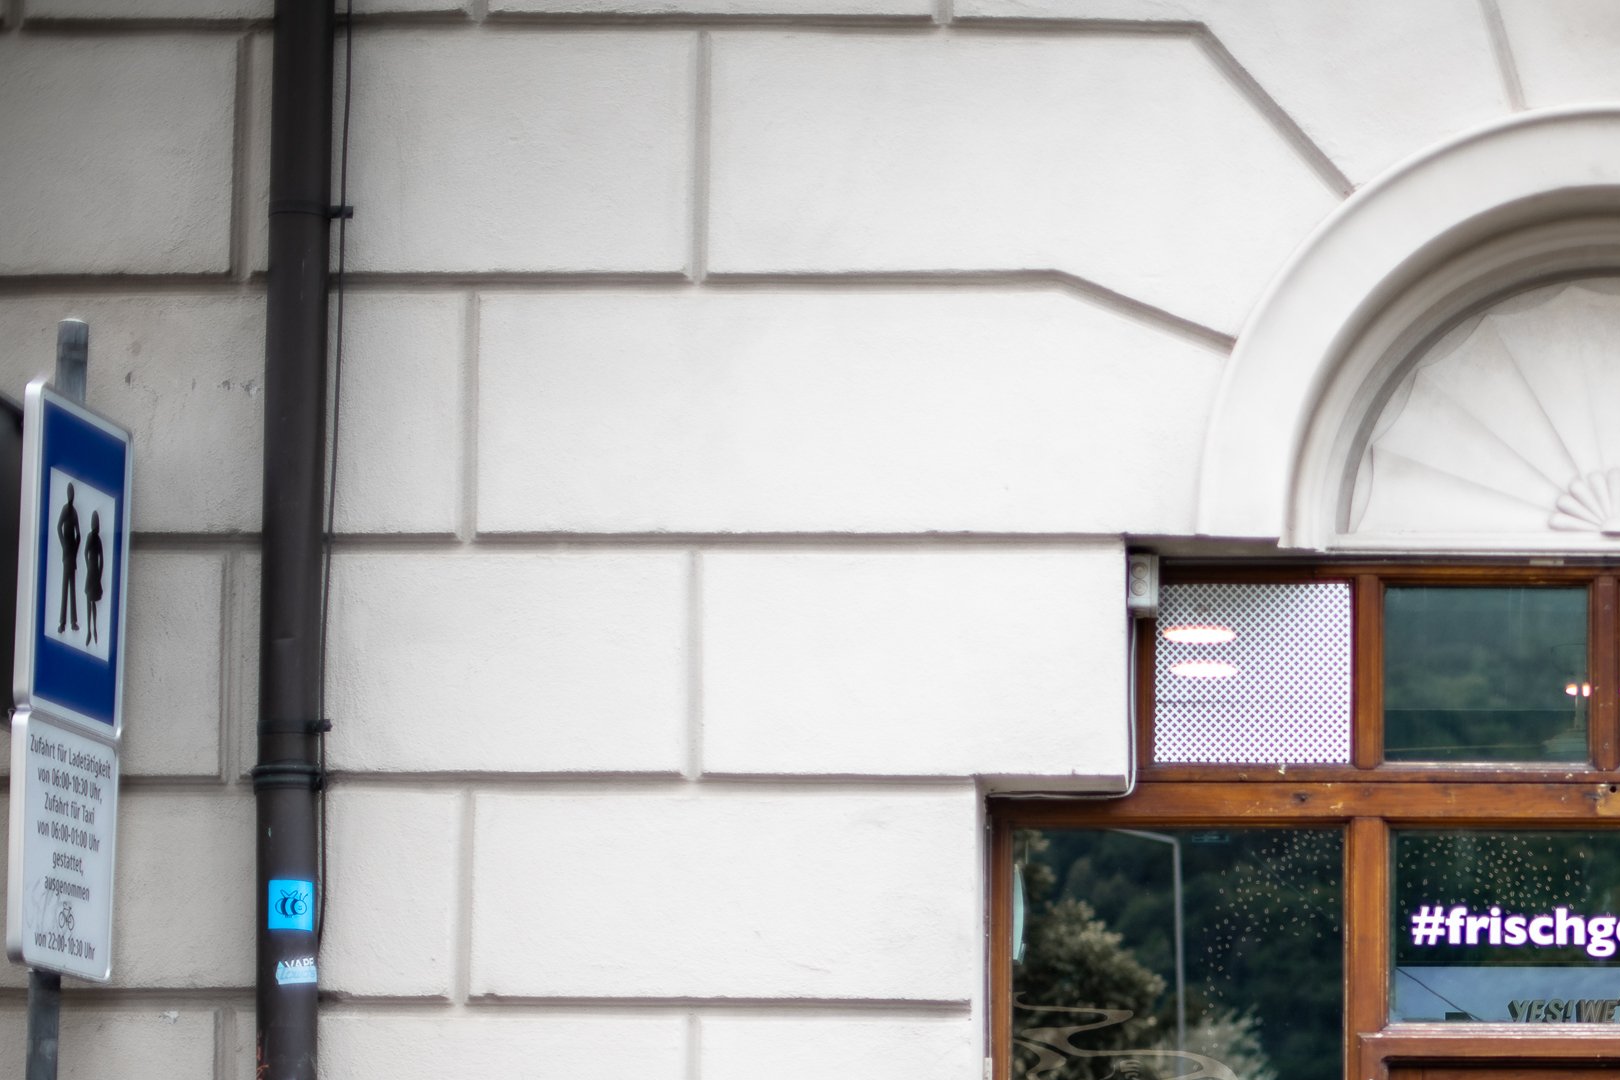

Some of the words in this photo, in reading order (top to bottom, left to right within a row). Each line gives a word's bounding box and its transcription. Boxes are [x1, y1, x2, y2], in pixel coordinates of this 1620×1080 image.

[30, 734, 55, 760] Zufahrt
[57, 744, 67, 763] für
[69, 748, 111, 779] Ladetätigkeit
[38, 767, 50, 783] von
[52, 768, 88, 797] 06:00-10:30
[90, 782, 103, 804] Uhr,
[45, 792, 69, 817] Zufahrt
[71, 801, 80, 820] für
[82, 804, 95, 825] Taxi
[37, 820, 50, 837] von
[51, 821, 87, 848] 06:00-01:00
[89, 833, 100, 853] Uhr
[52, 852, 84, 876] gestattet,
[44, 876, 90, 901] ausgenommen
[34, 931, 47, 949] von
[48, 931, 83, 957] 22:00-10:30
[84, 942, 96, 960] Uhr
[1508, 999, 1574, 1023] YES!
